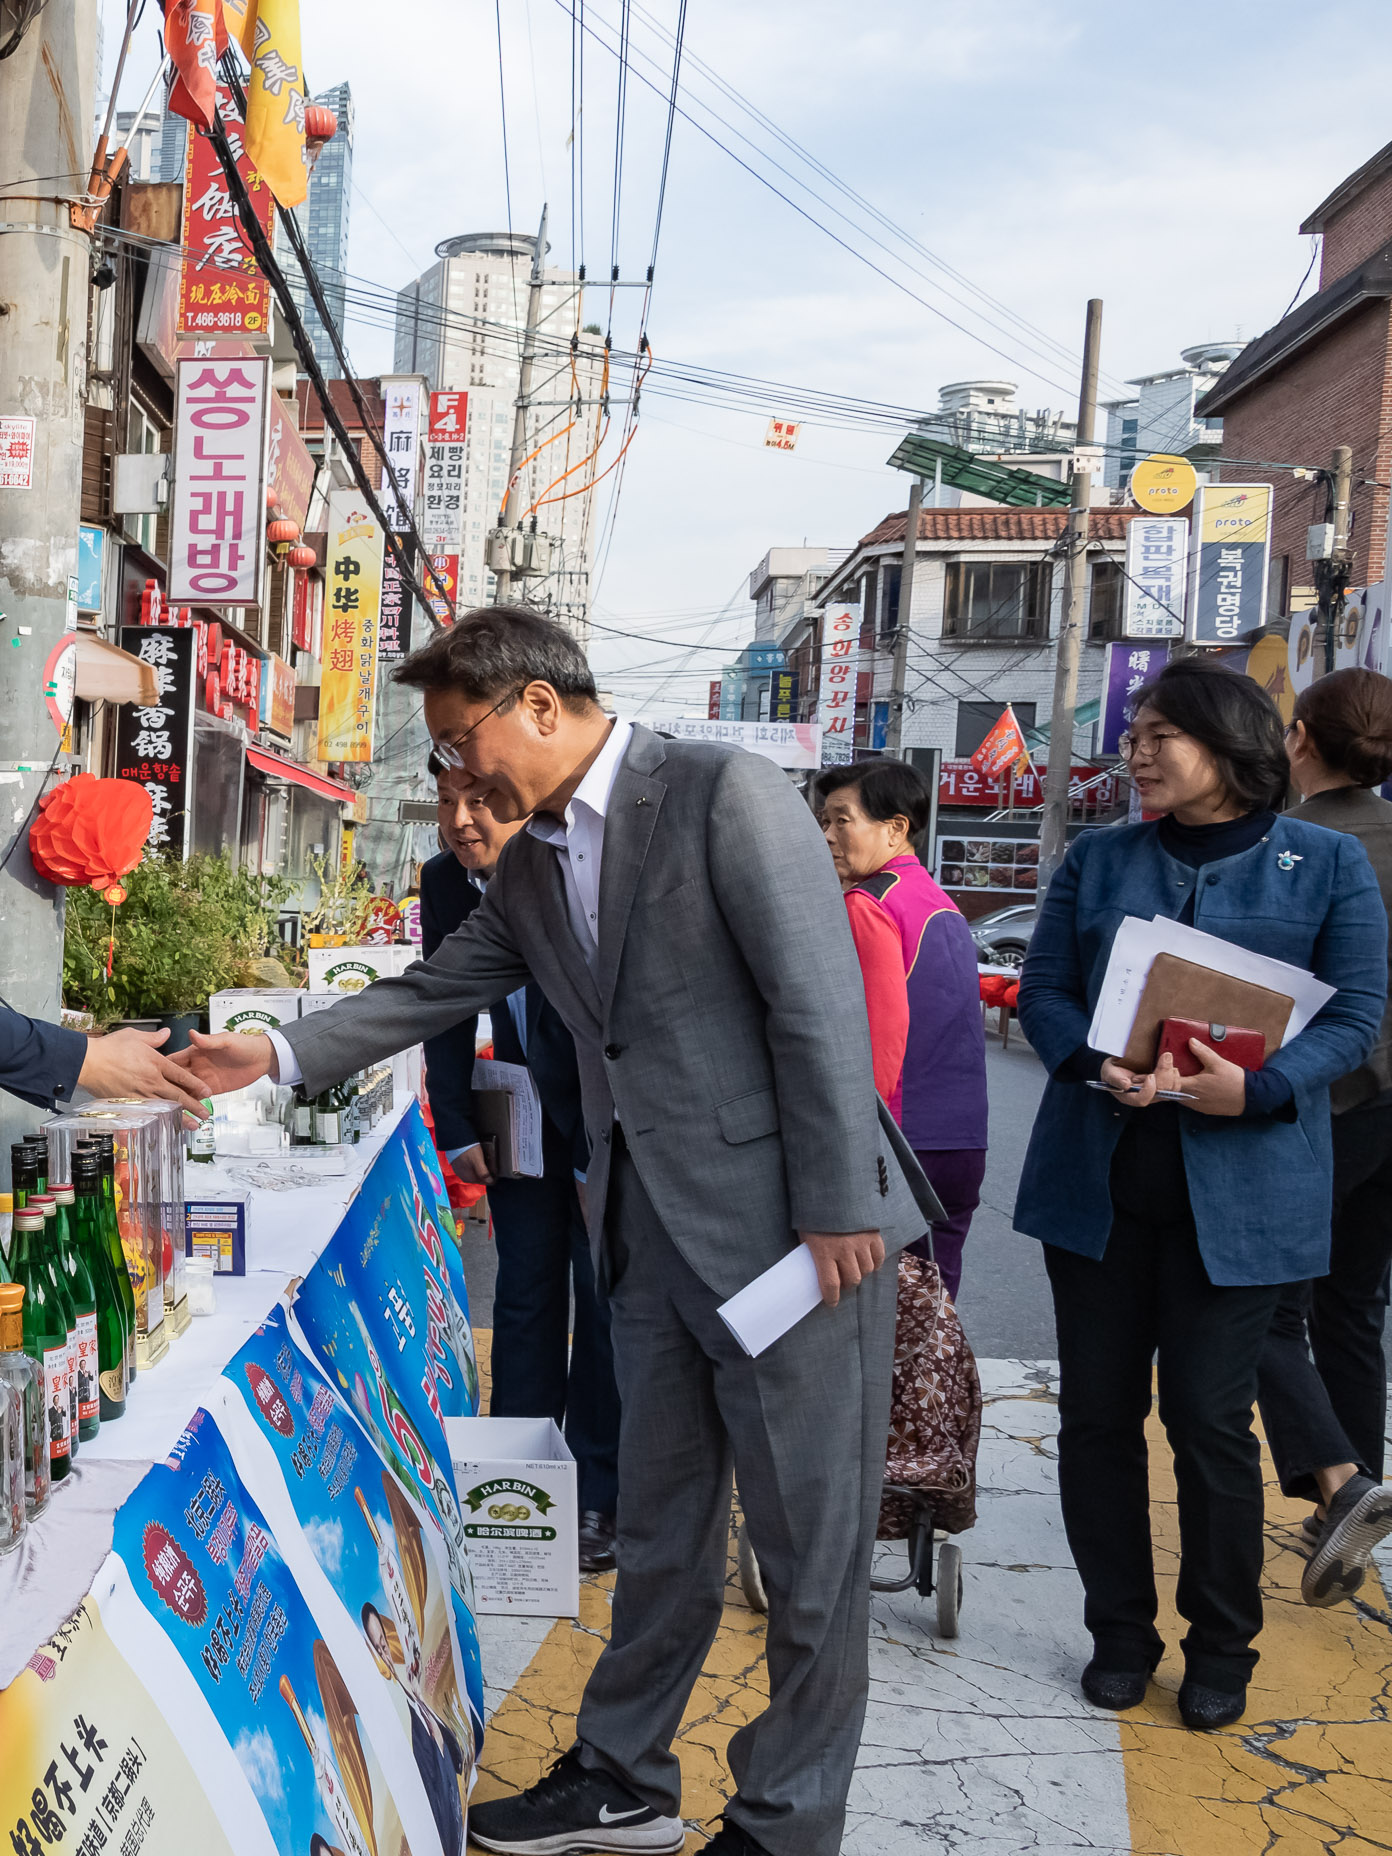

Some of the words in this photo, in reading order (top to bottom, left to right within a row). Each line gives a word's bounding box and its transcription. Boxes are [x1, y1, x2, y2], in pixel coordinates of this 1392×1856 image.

[186, 312, 242, 327] T.466-3618
[247, 316, 259, 325] 2F
[428, 446, 465, 462] 제빵
[184, 367, 257, 594] 쏭노래방
[428, 464, 463, 479] 요리
[1148, 487, 1178, 495] proto
[426, 494, 461, 511] 환경
[1215, 518, 1253, 528] proto
[1138, 525, 1177, 601] 합판목재
[1214, 548, 1245, 638] 복권명당
[356, 619, 375, 735] 중화닭날개구이
[826, 613, 854, 734] 송화양꼬치
[121, 762, 181, 782] 매운향솥
[333, 962, 369, 975] HARBIN
[233, 1010, 272, 1023] HARBIN
[78, 1339, 97, 1359] 皇家
[51, 1372, 68, 1394] 皇家
[481, 1481, 537, 1497] HARBIN
[476, 1526, 543, 1538] 哈尔滨啤酒
[172, 1570, 201, 1612] 순곡주
[9, 1714, 109, 1856] 好喝不上头
